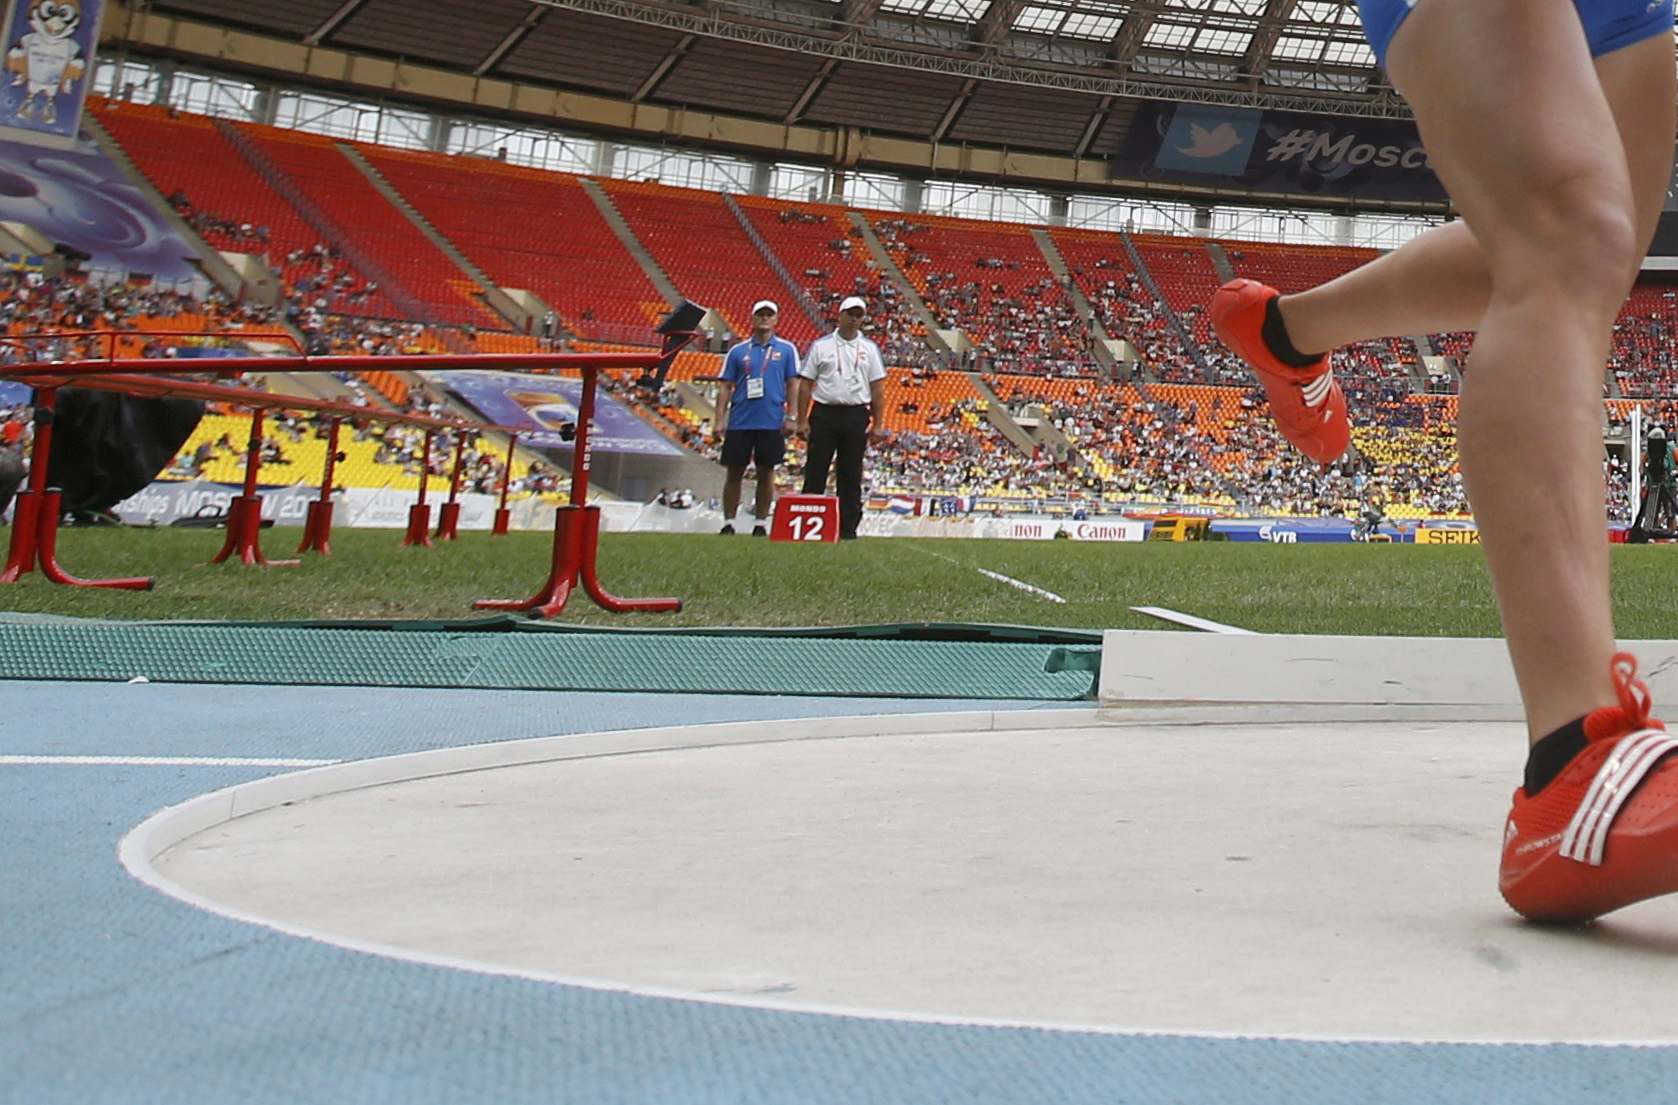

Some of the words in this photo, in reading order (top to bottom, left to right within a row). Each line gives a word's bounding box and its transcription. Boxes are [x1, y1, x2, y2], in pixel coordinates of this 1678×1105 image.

[790, 504, 826, 513] MONDO
[788, 515, 824, 541] 12
[1076, 523, 1126, 539] Canon
[1428, 531, 1480, 544] SEIK
